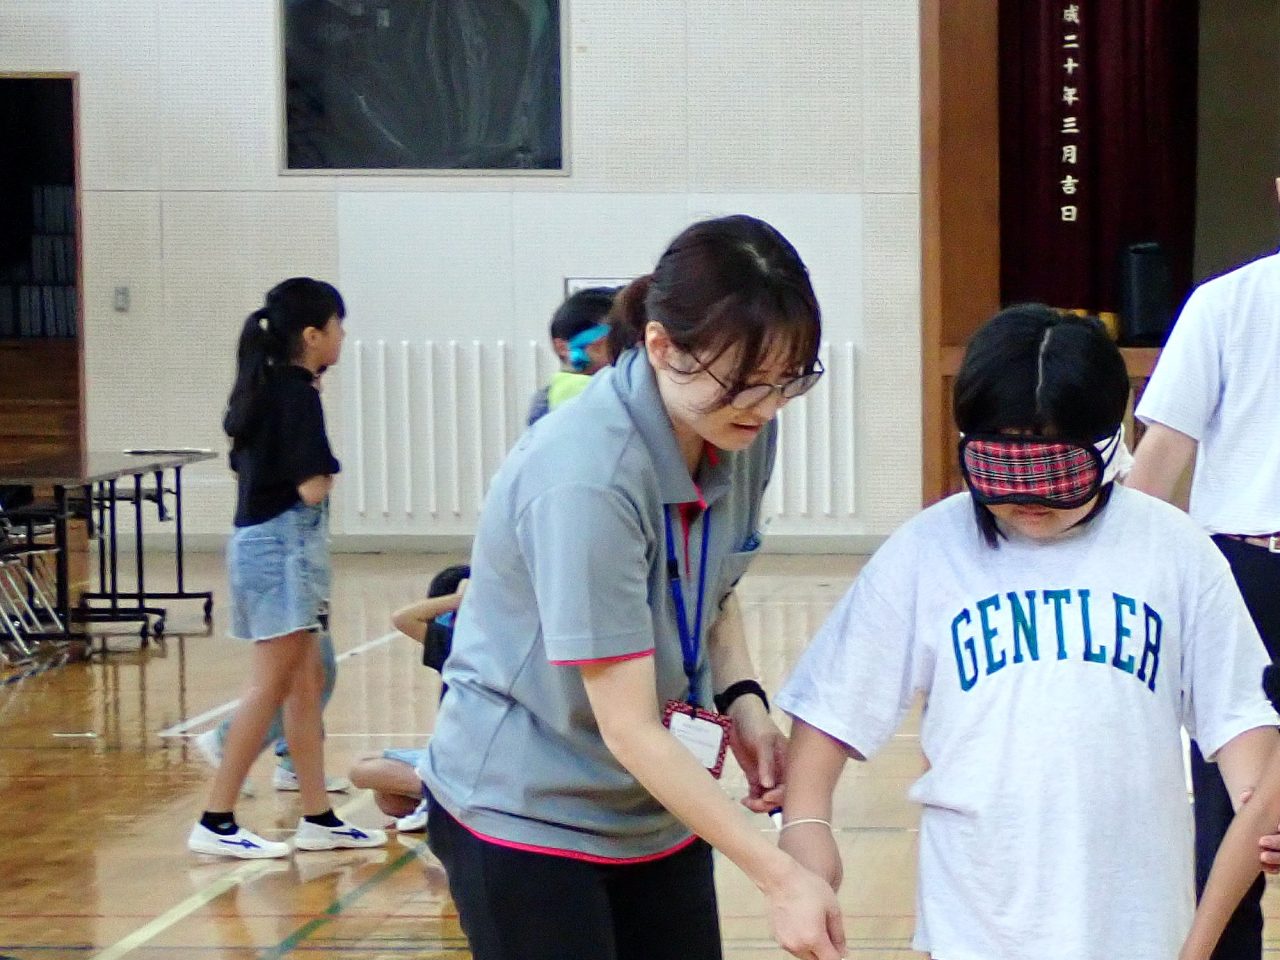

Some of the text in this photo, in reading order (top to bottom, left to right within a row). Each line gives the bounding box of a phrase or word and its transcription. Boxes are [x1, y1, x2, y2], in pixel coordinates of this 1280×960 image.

[1060, 4, 1080, 222] 成二十年三月吉日
[951, 588, 1163, 693] GENTLER
